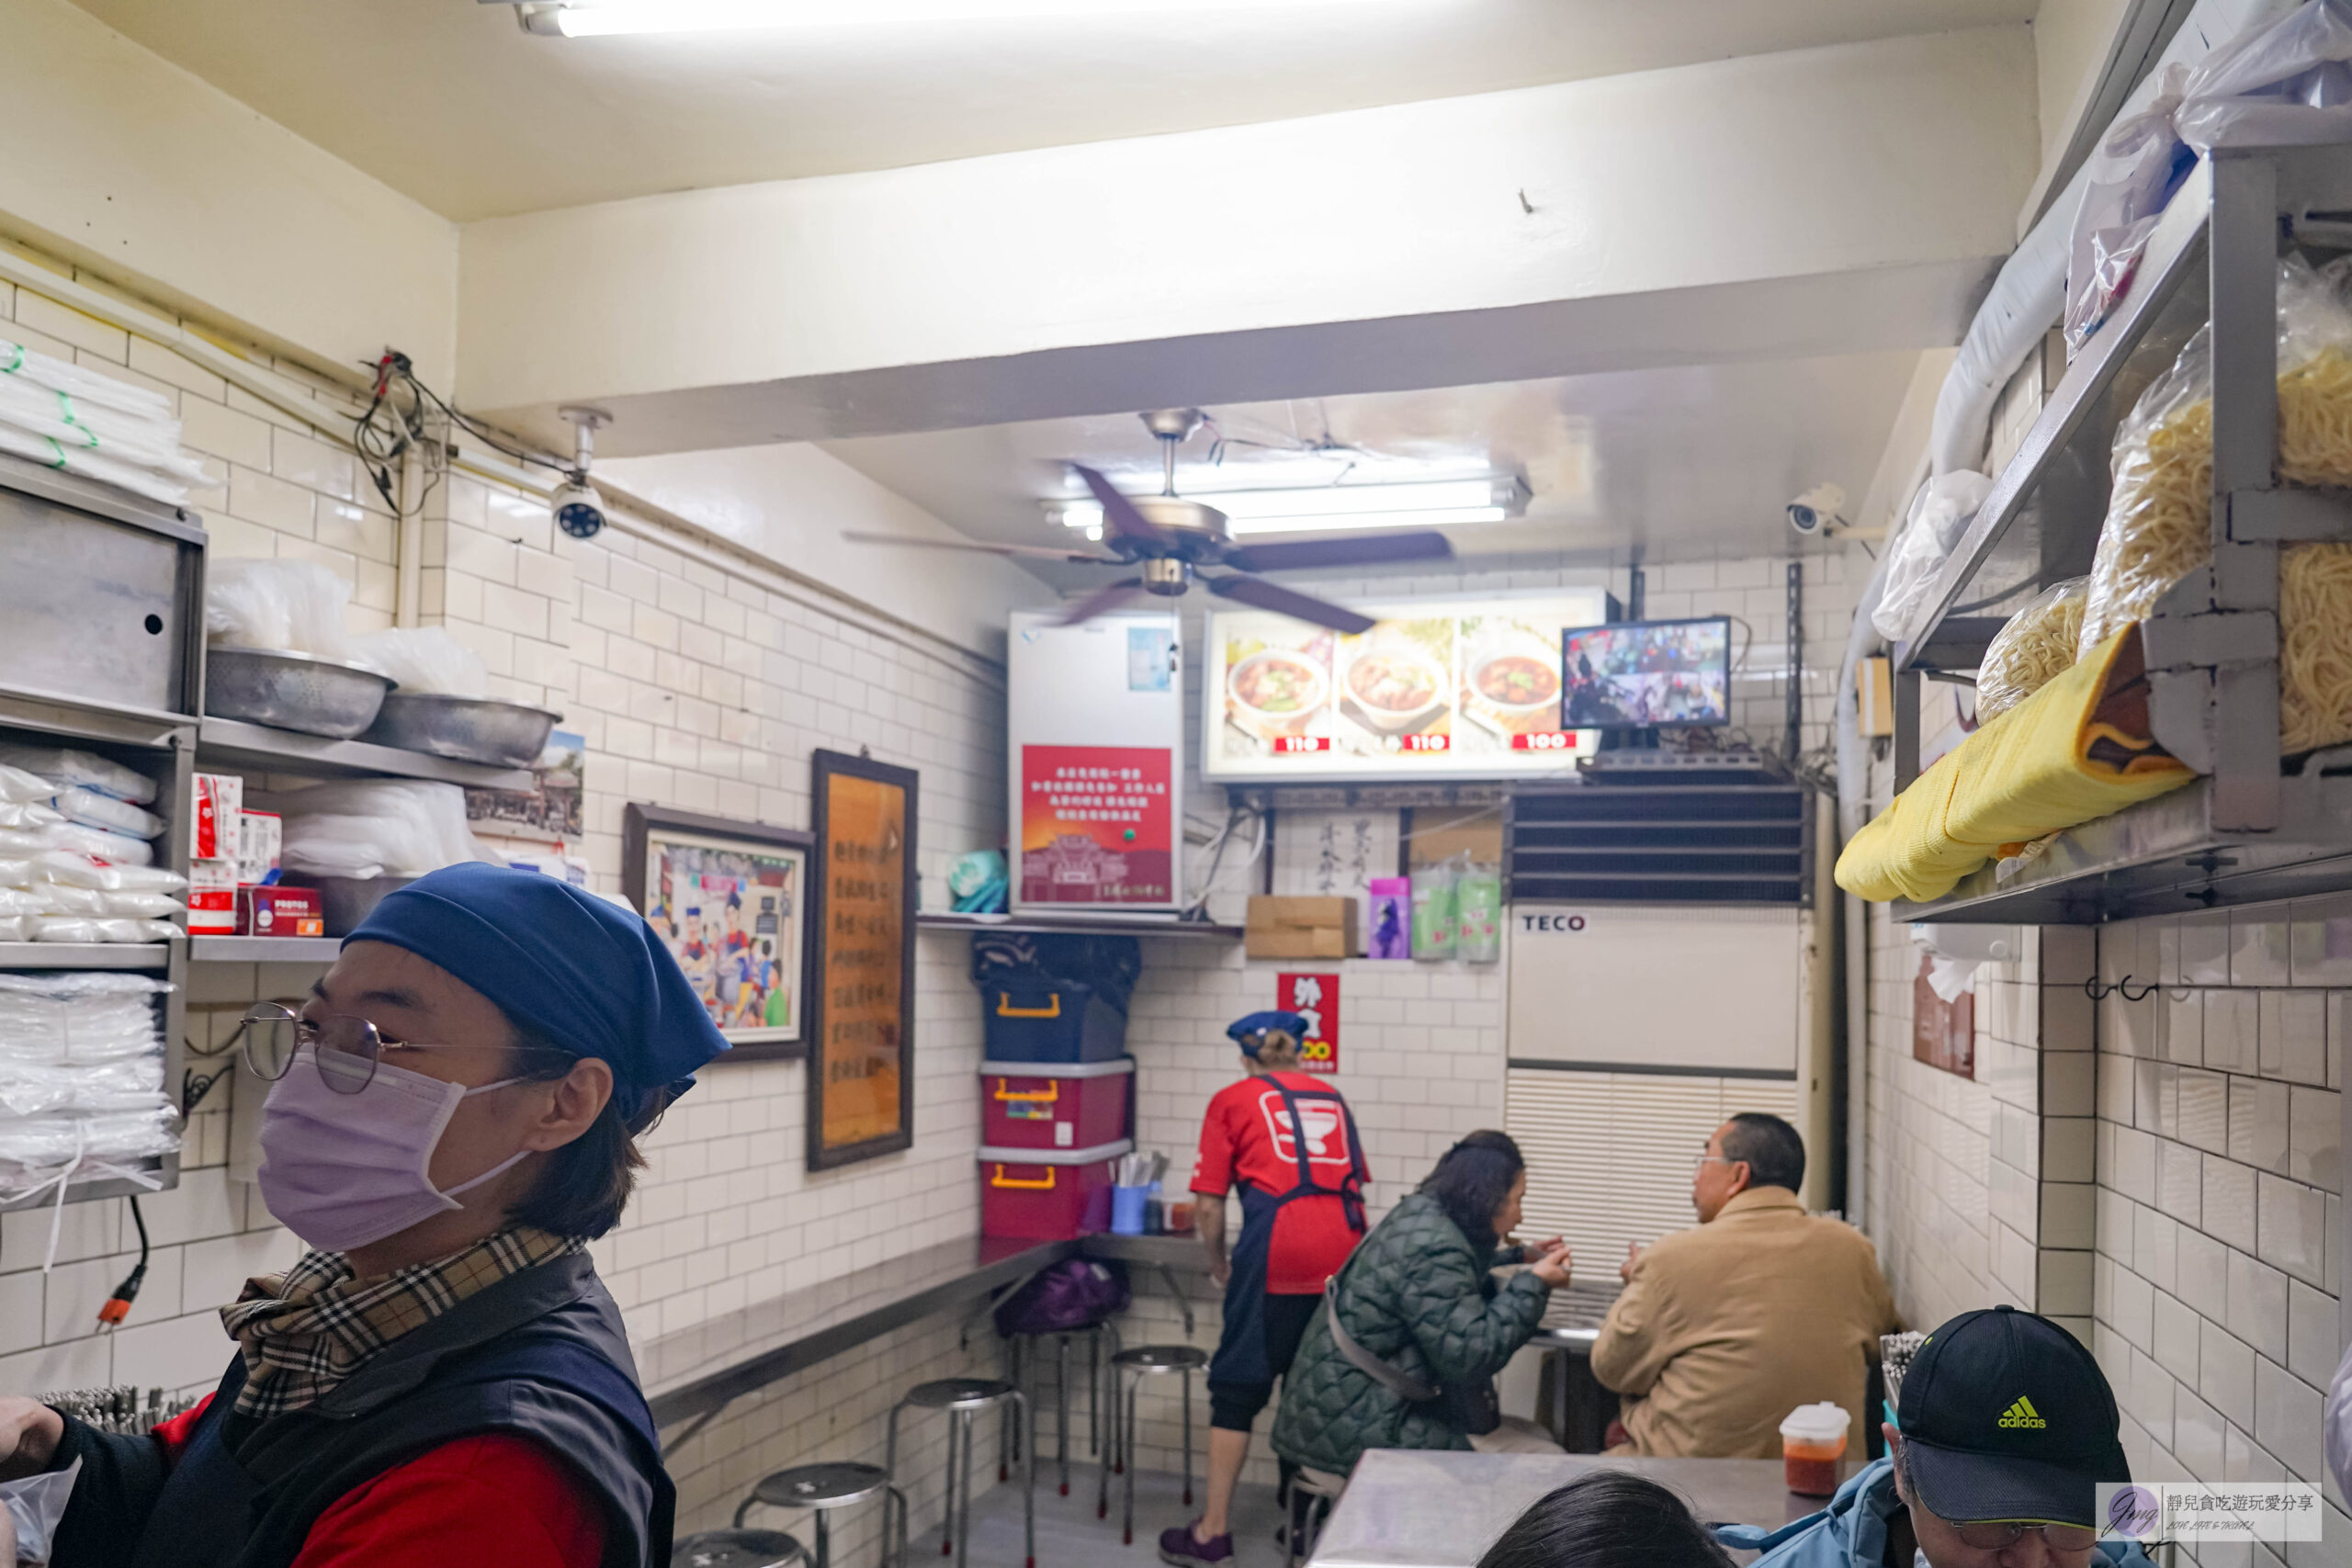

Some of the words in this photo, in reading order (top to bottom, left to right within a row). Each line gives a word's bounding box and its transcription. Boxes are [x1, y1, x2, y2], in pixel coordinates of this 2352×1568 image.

[1284, 736, 1318, 751] 110
[1410, 735, 1445, 750] 110
[1526, 733, 1566, 750] 100
[1521, 915, 1586, 931] TECO
[1997, 1415, 2047, 1429] adidas
